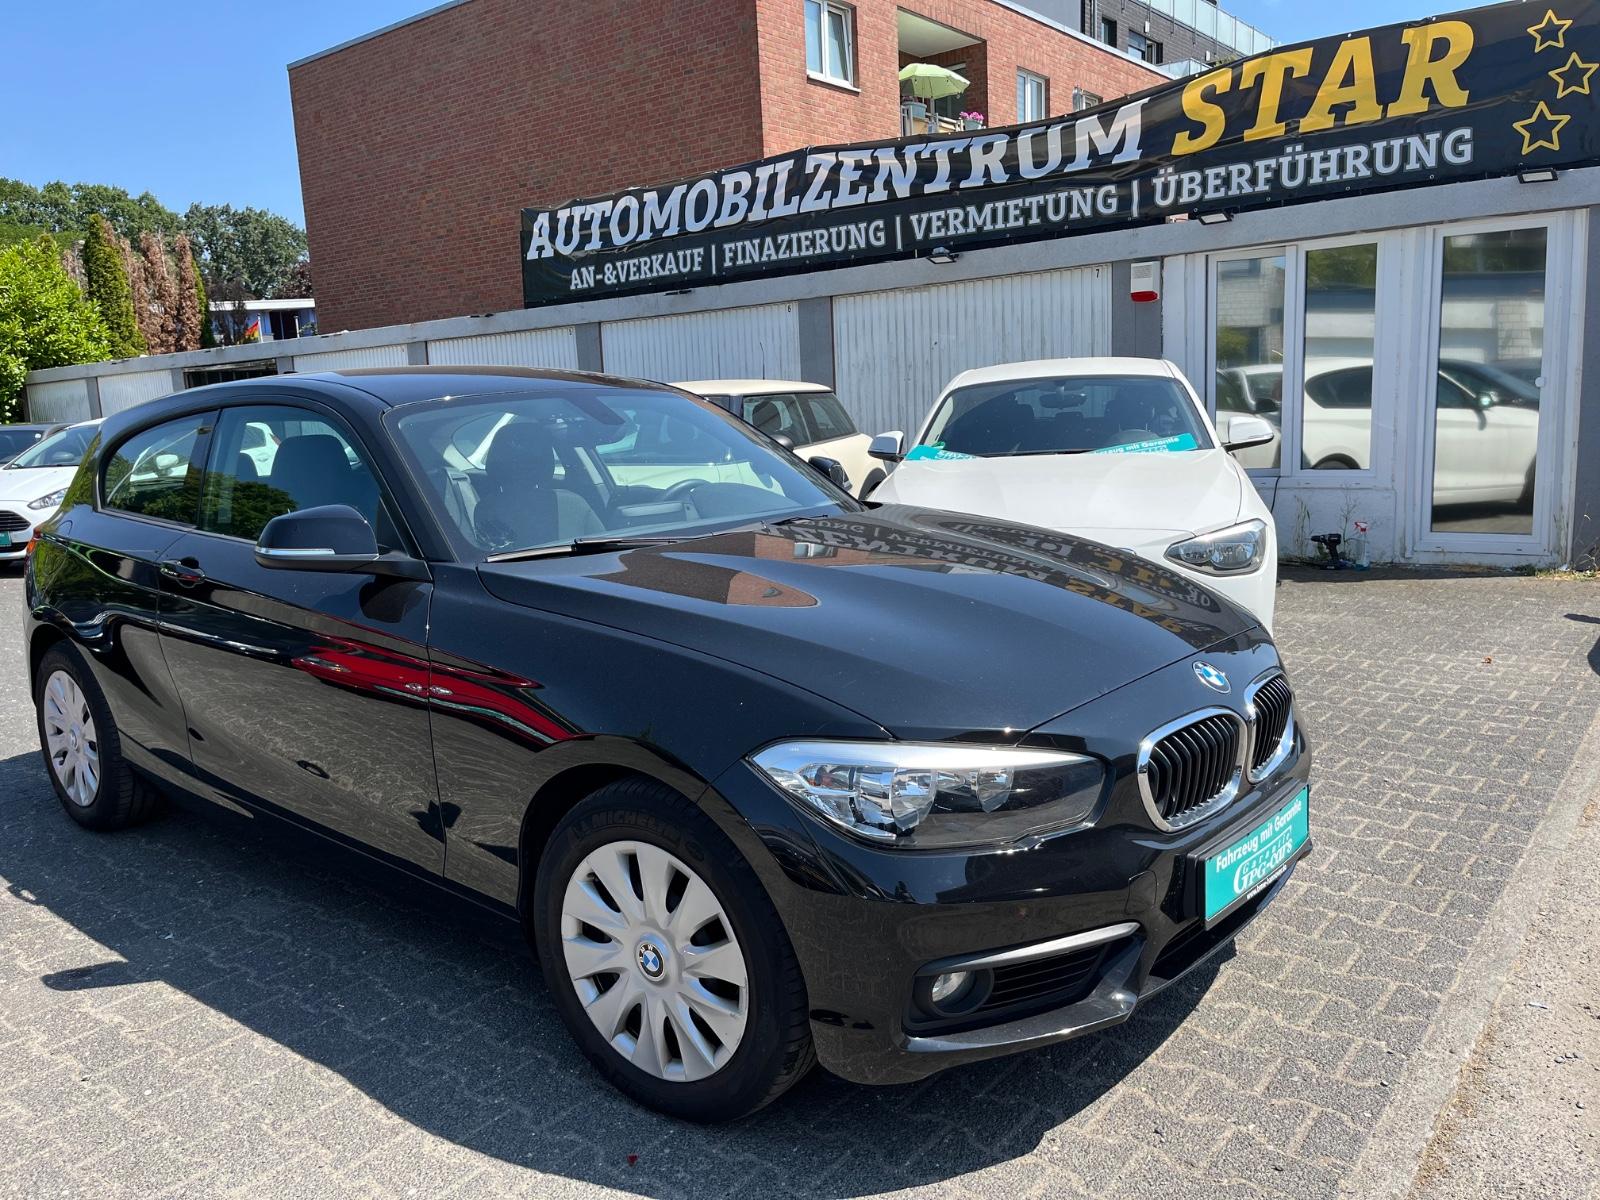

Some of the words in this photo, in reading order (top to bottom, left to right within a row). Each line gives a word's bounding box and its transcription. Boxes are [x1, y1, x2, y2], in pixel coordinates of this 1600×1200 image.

[526, 97, 1150, 260] AUTOMOBILZENTRUM
[1171, 20, 1474, 156] STAR
[569, 248, 704, 290] AN-&VERKAUF
[723, 219, 886, 268] FINAZIERUNG
[910, 184, 1119, 241] VERMIETUNG
[1153, 126, 1474, 206] ÜBERFÜHRUNG
[1216, 835, 1259, 872] Fahrzeug
[1260, 822, 1273, 844] mit
[1274, 799, 1302, 832] Garantie
